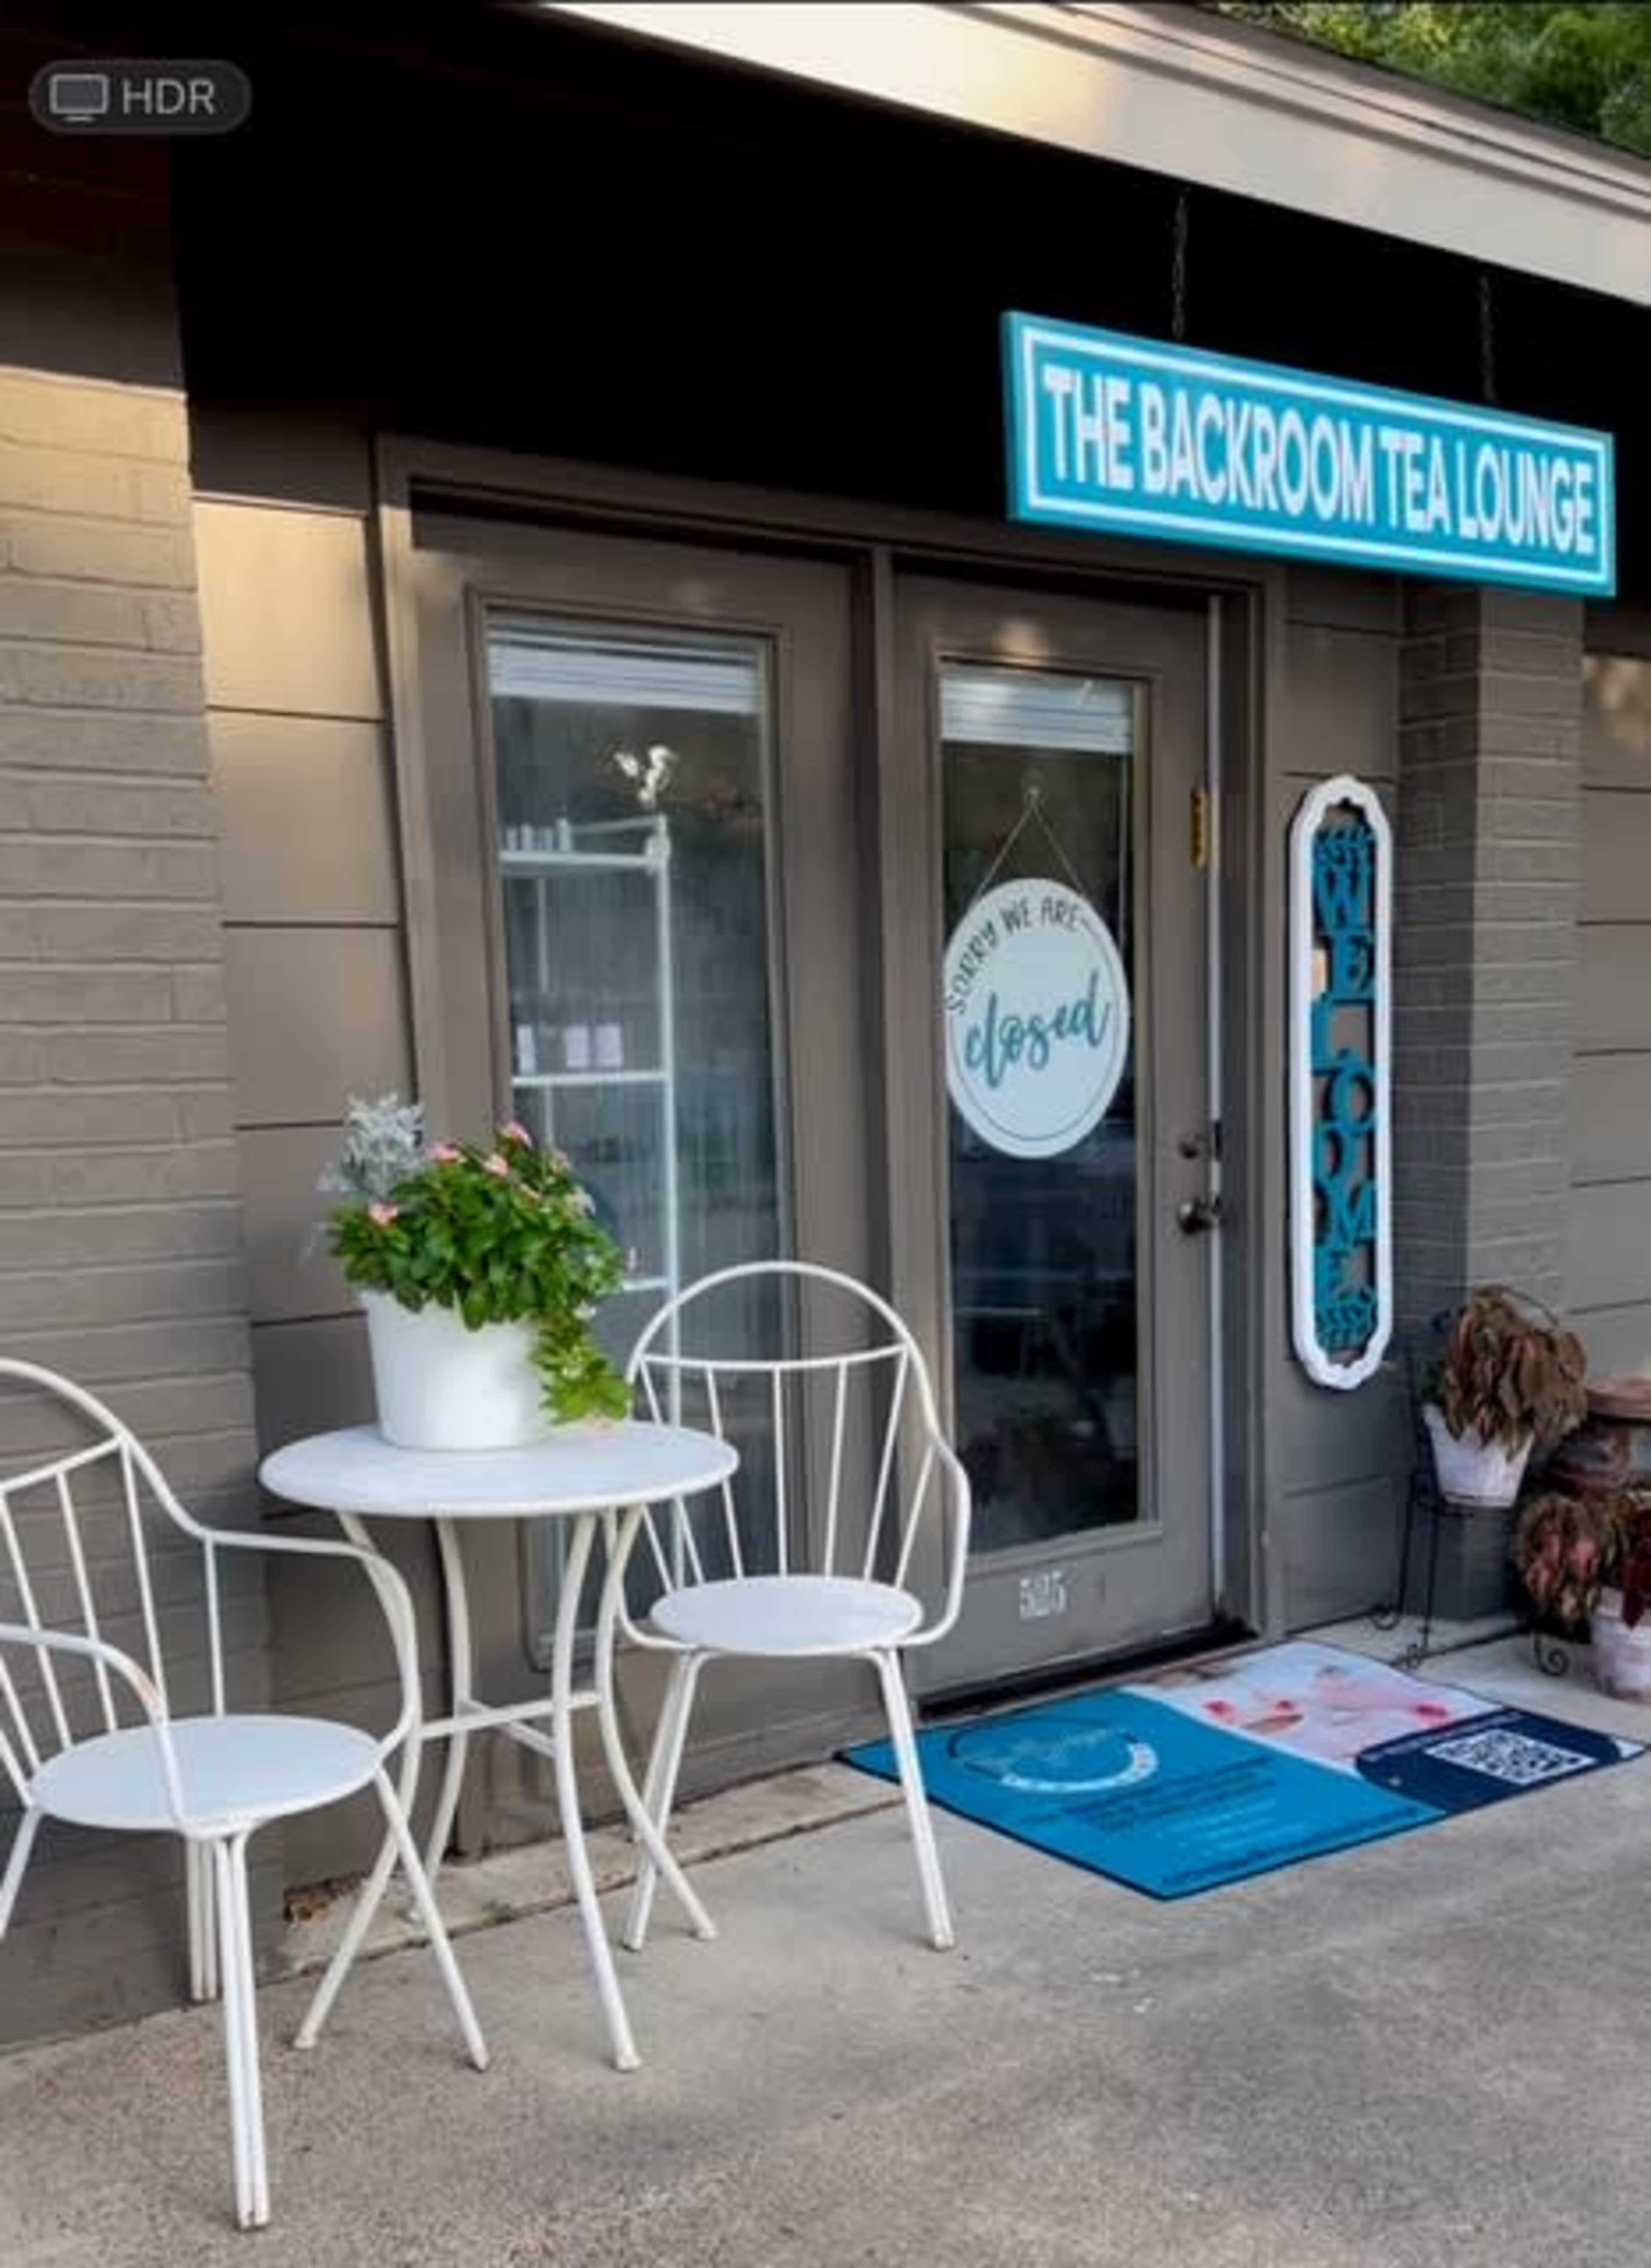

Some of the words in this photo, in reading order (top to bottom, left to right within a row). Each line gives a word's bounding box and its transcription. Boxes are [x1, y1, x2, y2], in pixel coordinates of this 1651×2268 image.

[1042, 363, 1133, 491] THE
[1139, 381, 1374, 526] BACKROOM
[1379, 426, 1452, 537] TEA
[1459, 438, 1595, 556] LOUNGE
[946, 920, 999, 1015] SORRY
[1000, 897, 1031, 936] WE
[1040, 896, 1080, 931] ARE
[965, 968, 1111, 1089] closed
